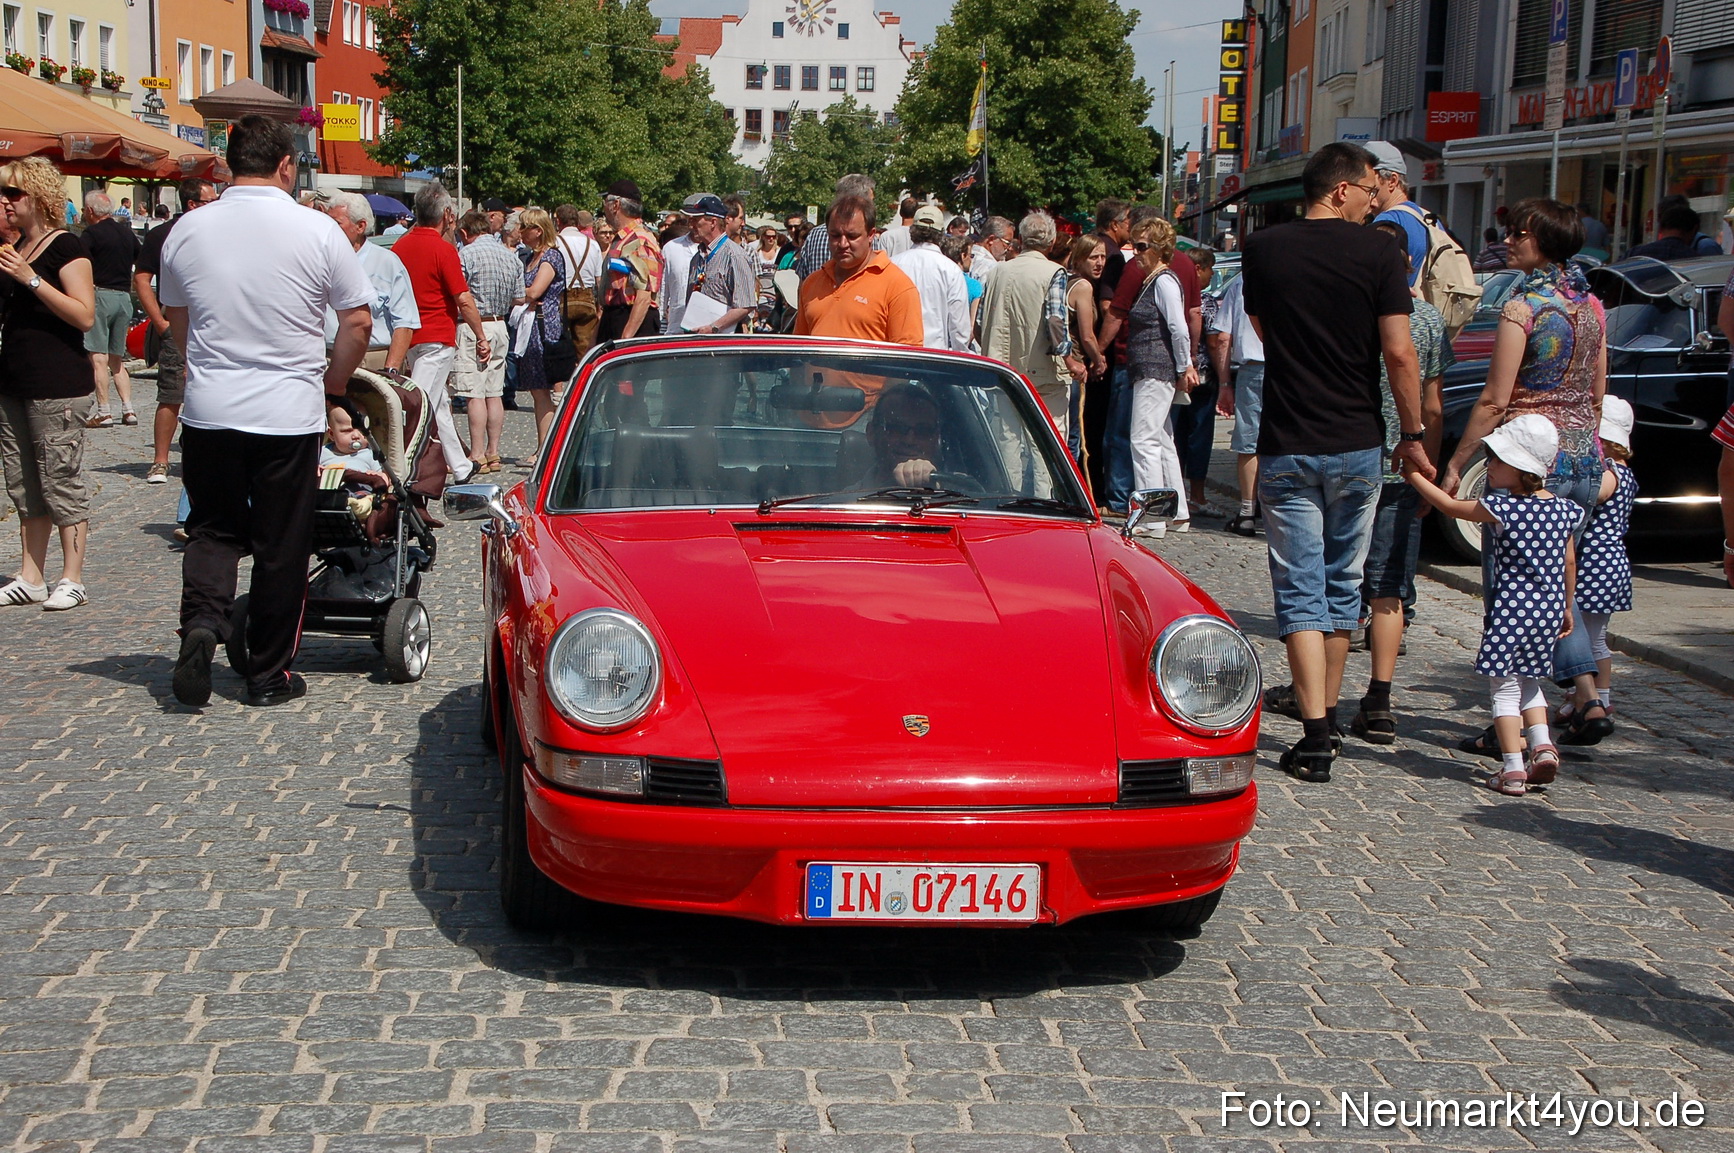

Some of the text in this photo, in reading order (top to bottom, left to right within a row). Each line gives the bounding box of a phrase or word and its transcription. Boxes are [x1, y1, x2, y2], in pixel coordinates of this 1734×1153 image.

[142, 78, 157, 87] KINO
[1218, 21, 1245, 149] HOTEL
[1618, 57, 1632, 99] P
[1430, 110, 1477, 124] ESPRIT
[400, 525, 408, 595] CRUISER
[815, 896, 825, 909] D
[838, 871, 1028, 914] IN 07146
